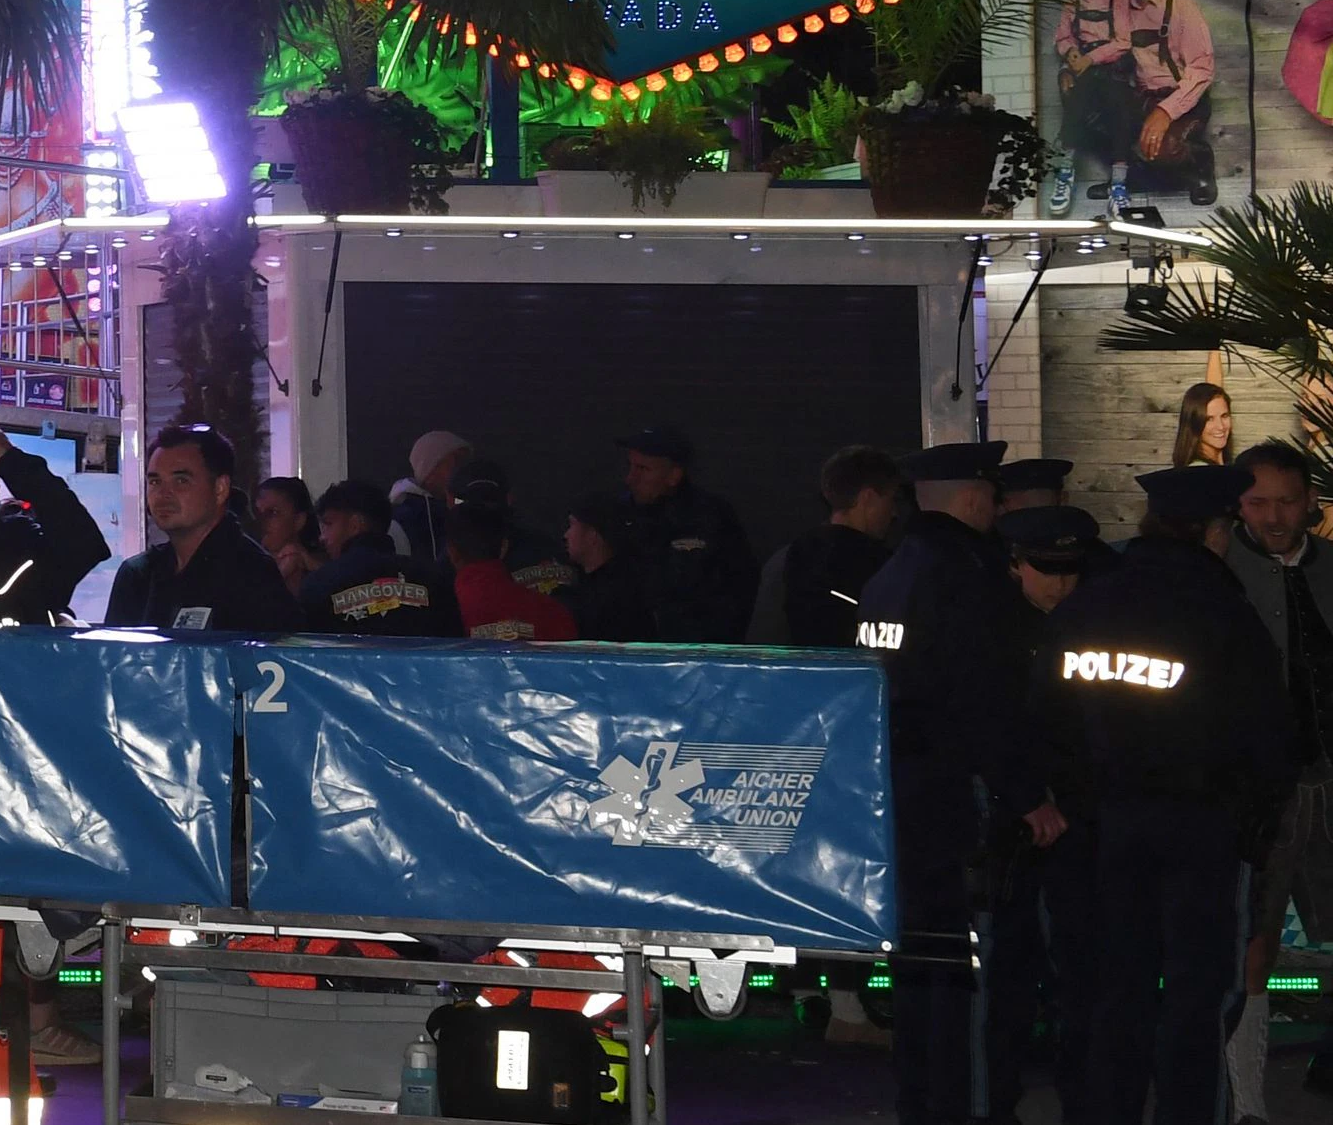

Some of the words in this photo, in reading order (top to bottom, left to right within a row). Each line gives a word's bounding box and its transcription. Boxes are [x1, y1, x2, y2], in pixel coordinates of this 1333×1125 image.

[334, 583, 427, 607] HANGOVER
[1063, 651, 1185, 689] POLIZEI
[253, 661, 289, 713] 2
[732, 771, 815, 790] AICHER
[688, 787, 810, 808] AMBULANZ
[734, 809, 803, 827] UNION
